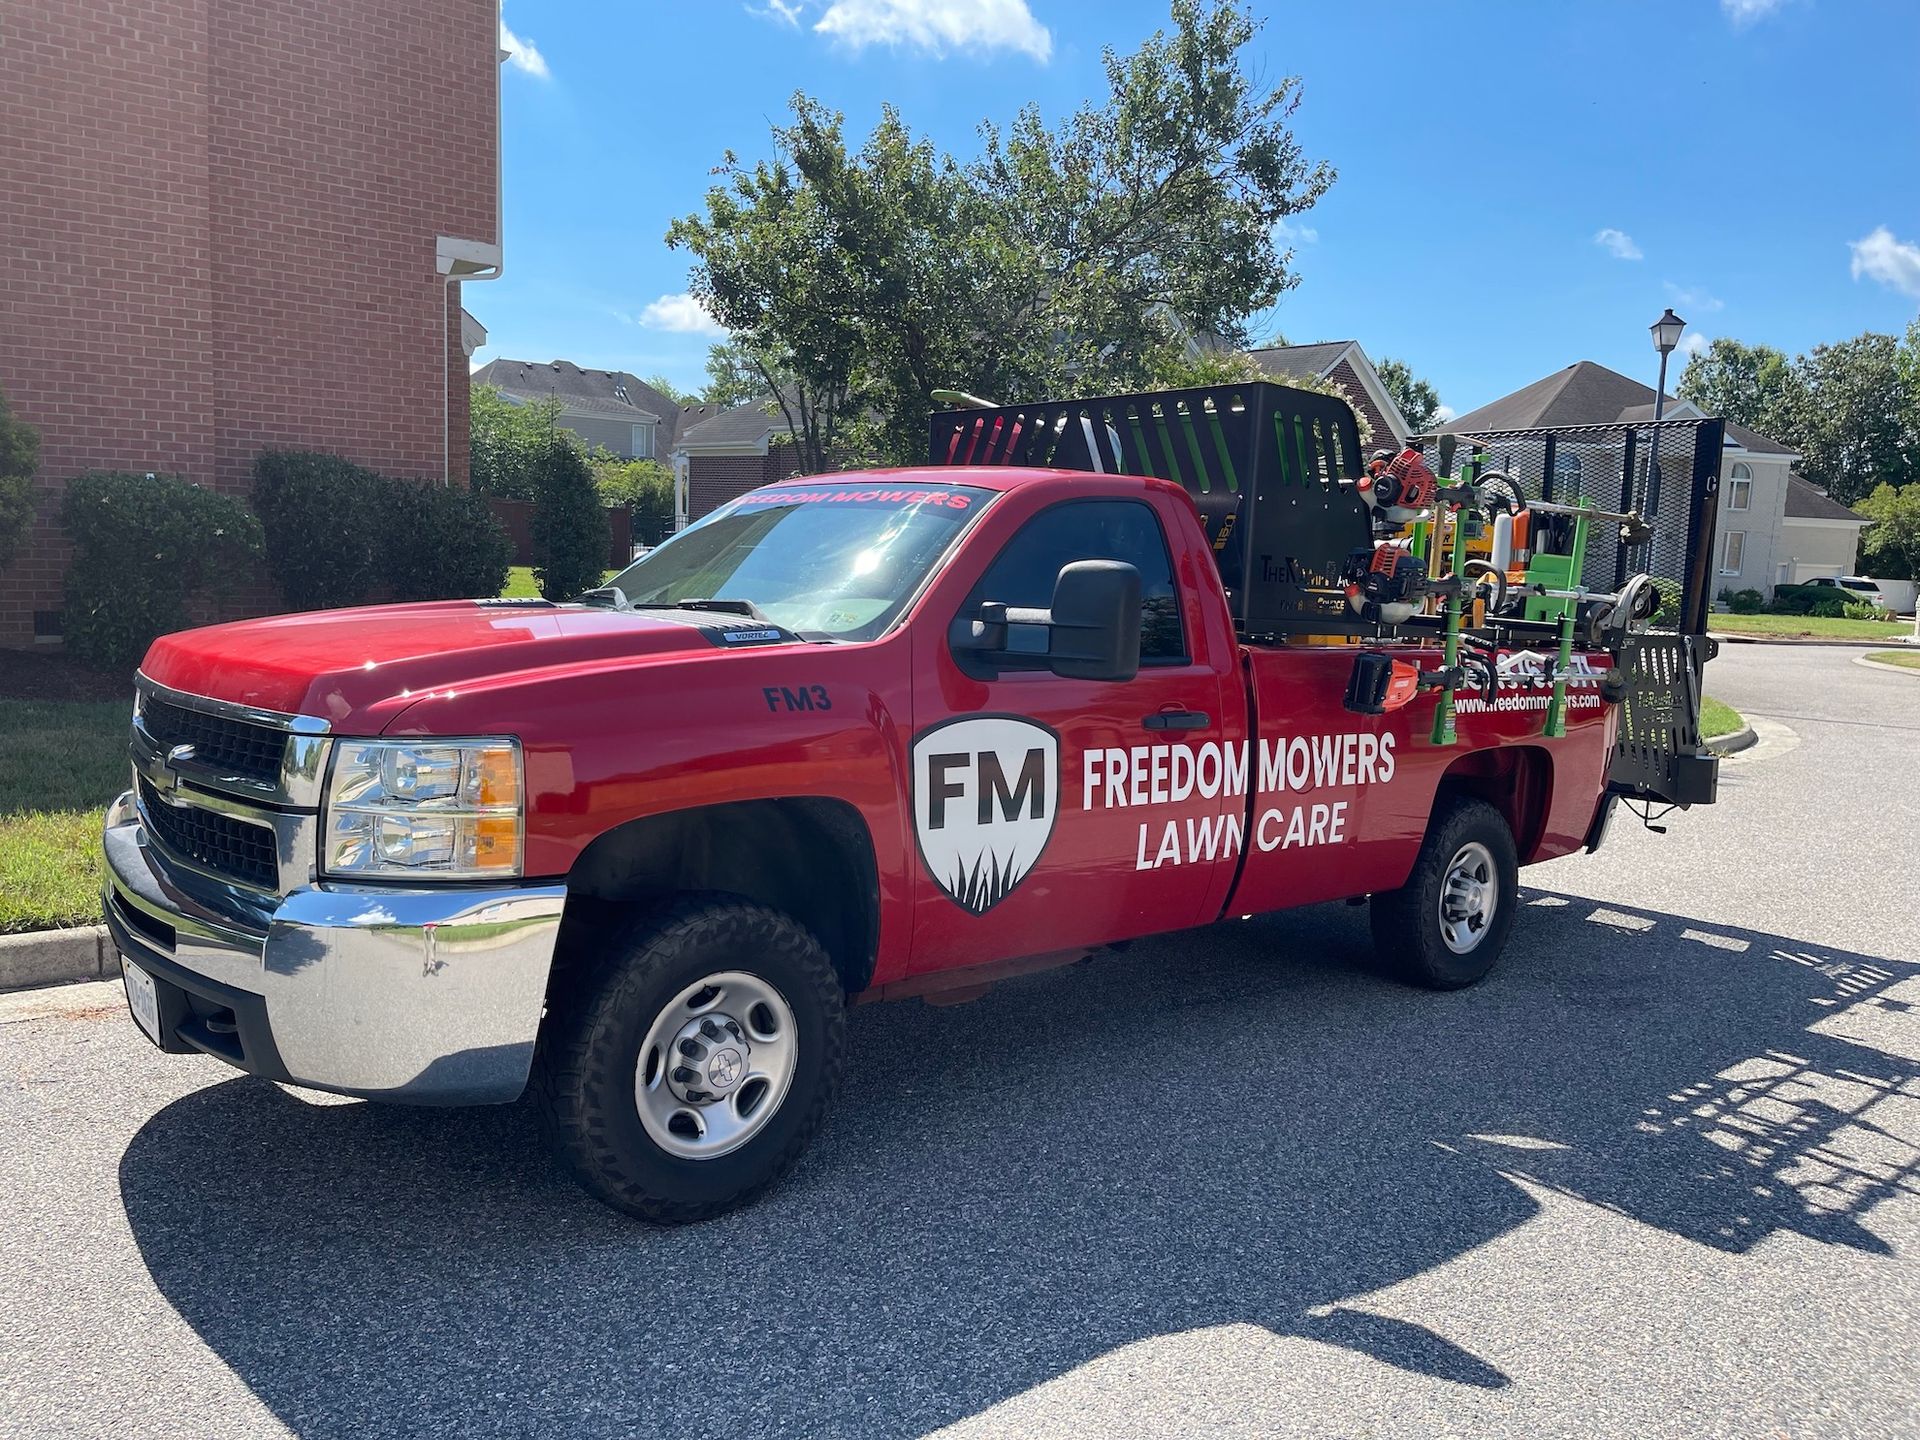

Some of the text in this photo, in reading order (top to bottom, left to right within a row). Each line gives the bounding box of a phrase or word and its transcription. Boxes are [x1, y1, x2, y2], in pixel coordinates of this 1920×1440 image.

[828, 490, 971, 510] MOWERS
[736, 632, 769, 640] VORTEC
[763, 685, 832, 712] FM3
[1455, 693, 1600, 714] www.reedommors.com
[1083, 732, 1396, 811] FREEDOM MOWERS
[929, 748, 1045, 830] FM
[1136, 801, 1348, 871] LAWN CARE
